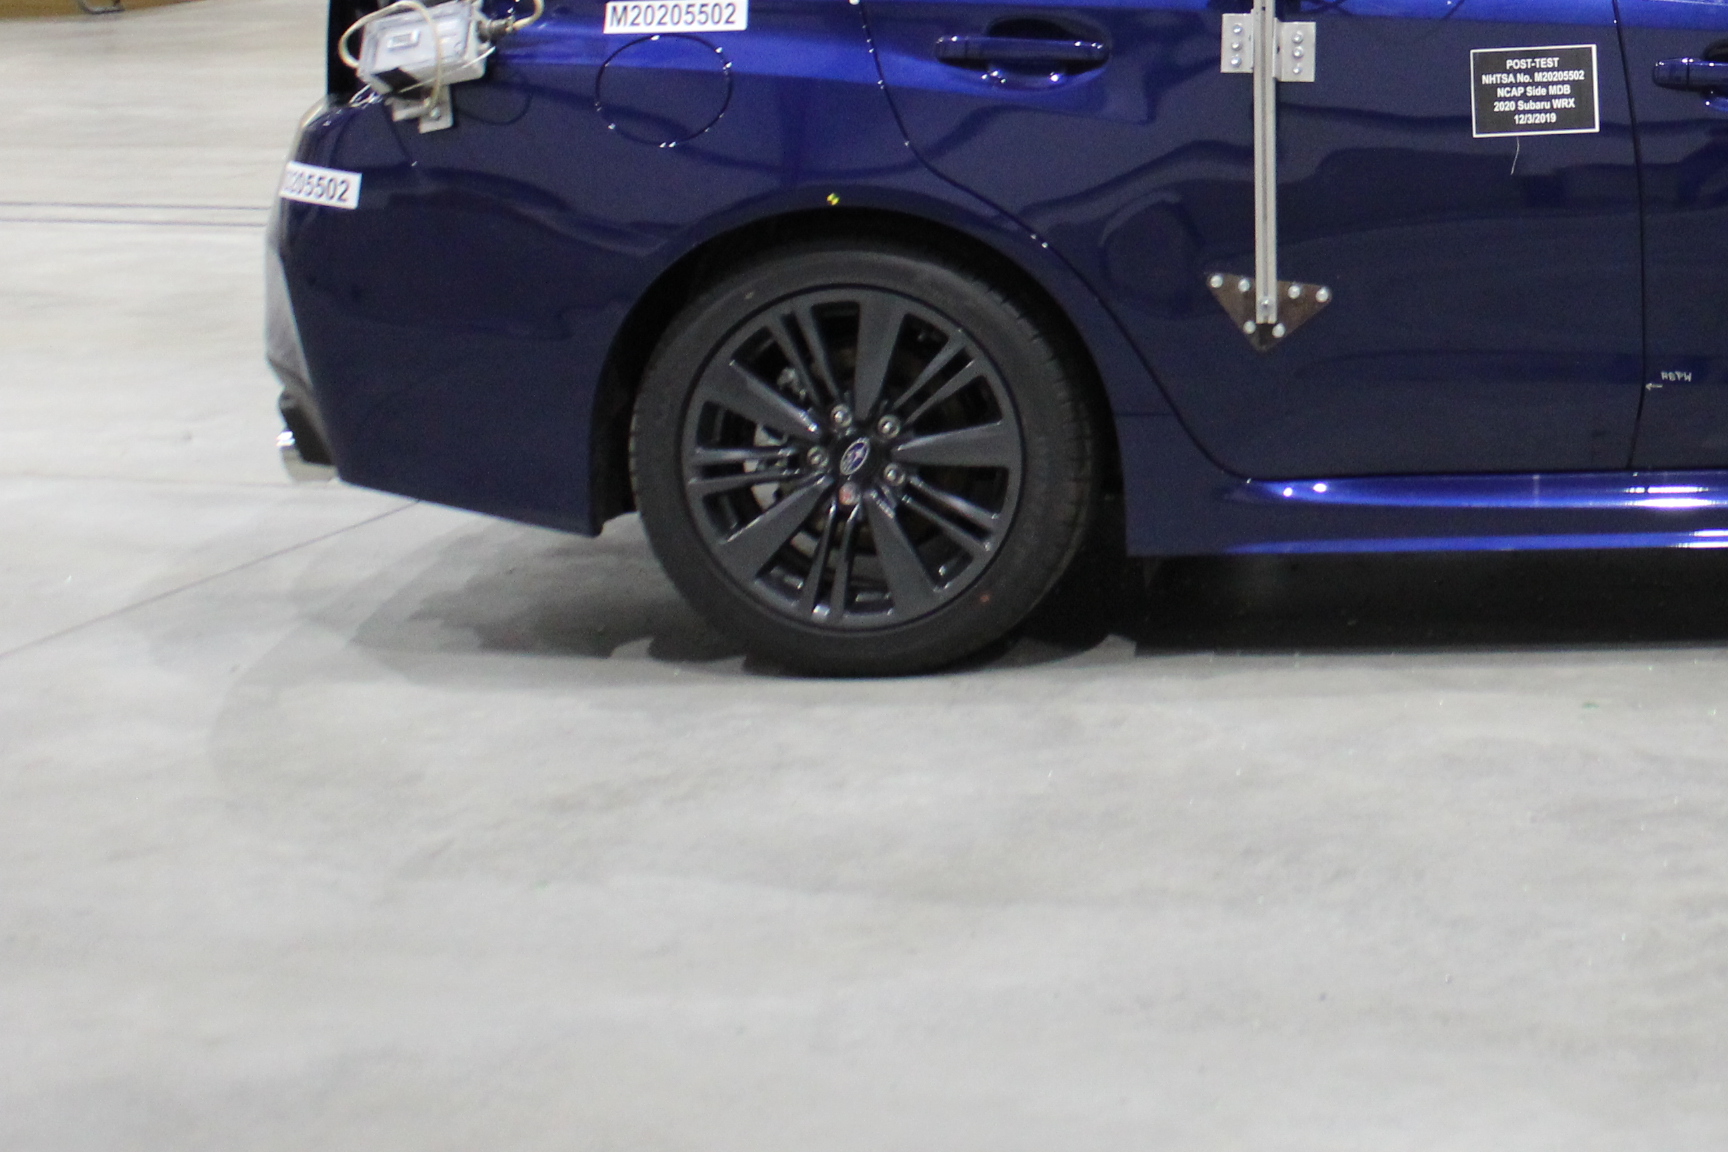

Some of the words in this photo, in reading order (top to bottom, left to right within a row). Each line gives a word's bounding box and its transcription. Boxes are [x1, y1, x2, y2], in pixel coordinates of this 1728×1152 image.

[609, 2, 736, 27] M20205502
[1506, 57, 1560, 69] POST-TEST
[1481, 73, 1515, 84] NHTSA
[1517, 73, 1532, 83] No.
[1534, 70, 1585, 83] M20205502
[1497, 87, 1524, 97] NCAP
[1526, 85, 1546, 96] Side
[1549, 84, 1571, 95] MDB
[1493, 101, 1516, 111] 2020
[1517, 100, 1550, 110] Subaru
[1552, 98, 1575, 109] WRX
[1514, 112, 1557, 124] 12/3/2019
